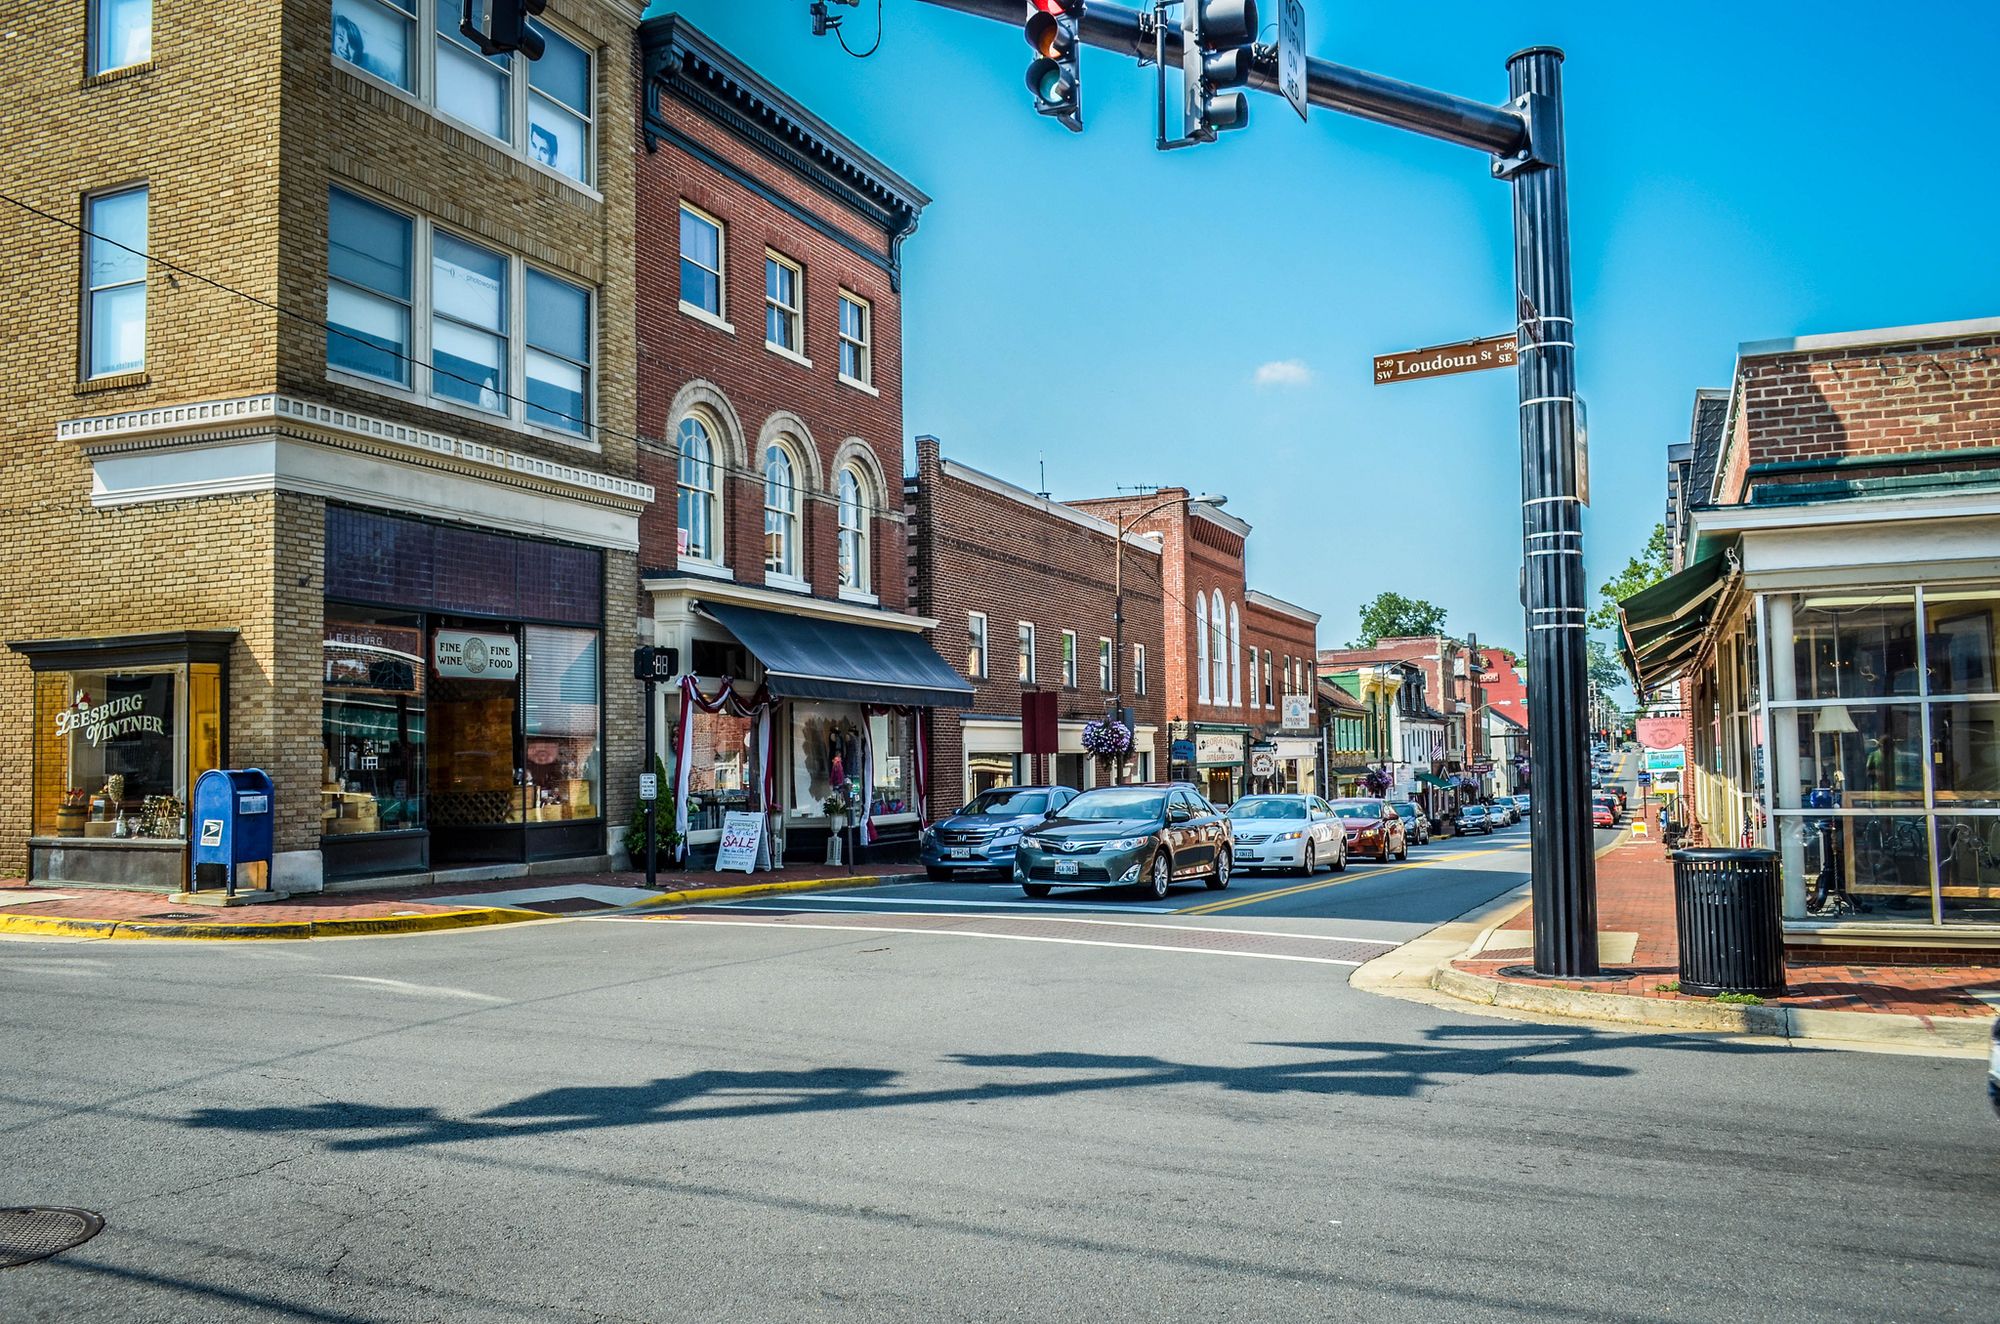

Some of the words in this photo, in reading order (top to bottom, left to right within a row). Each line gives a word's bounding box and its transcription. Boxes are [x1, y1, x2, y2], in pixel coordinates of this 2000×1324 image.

[1284, 19, 1300, 56] TURN
[1288, 50, 1298, 74] ON
[1287, 72, 1299, 101] RED
[1376, 359, 1394, 369] 1-99
[1396, 354, 1477, 376] Loudoun
[1481, 350, 1492, 361] St
[1498, 353, 1512, 364] SE
[1376, 370, 1393, 380] SW
[440, 642, 461, 653] FINE
[490, 646, 510, 656] FINE
[437, 655, 462, 666] WINE
[489, 659, 513, 669] FOOD
[55, 694, 143, 736] LEESBURG
[86, 715, 164, 748] VINTNER
[722, 835, 756, 848] SALE
